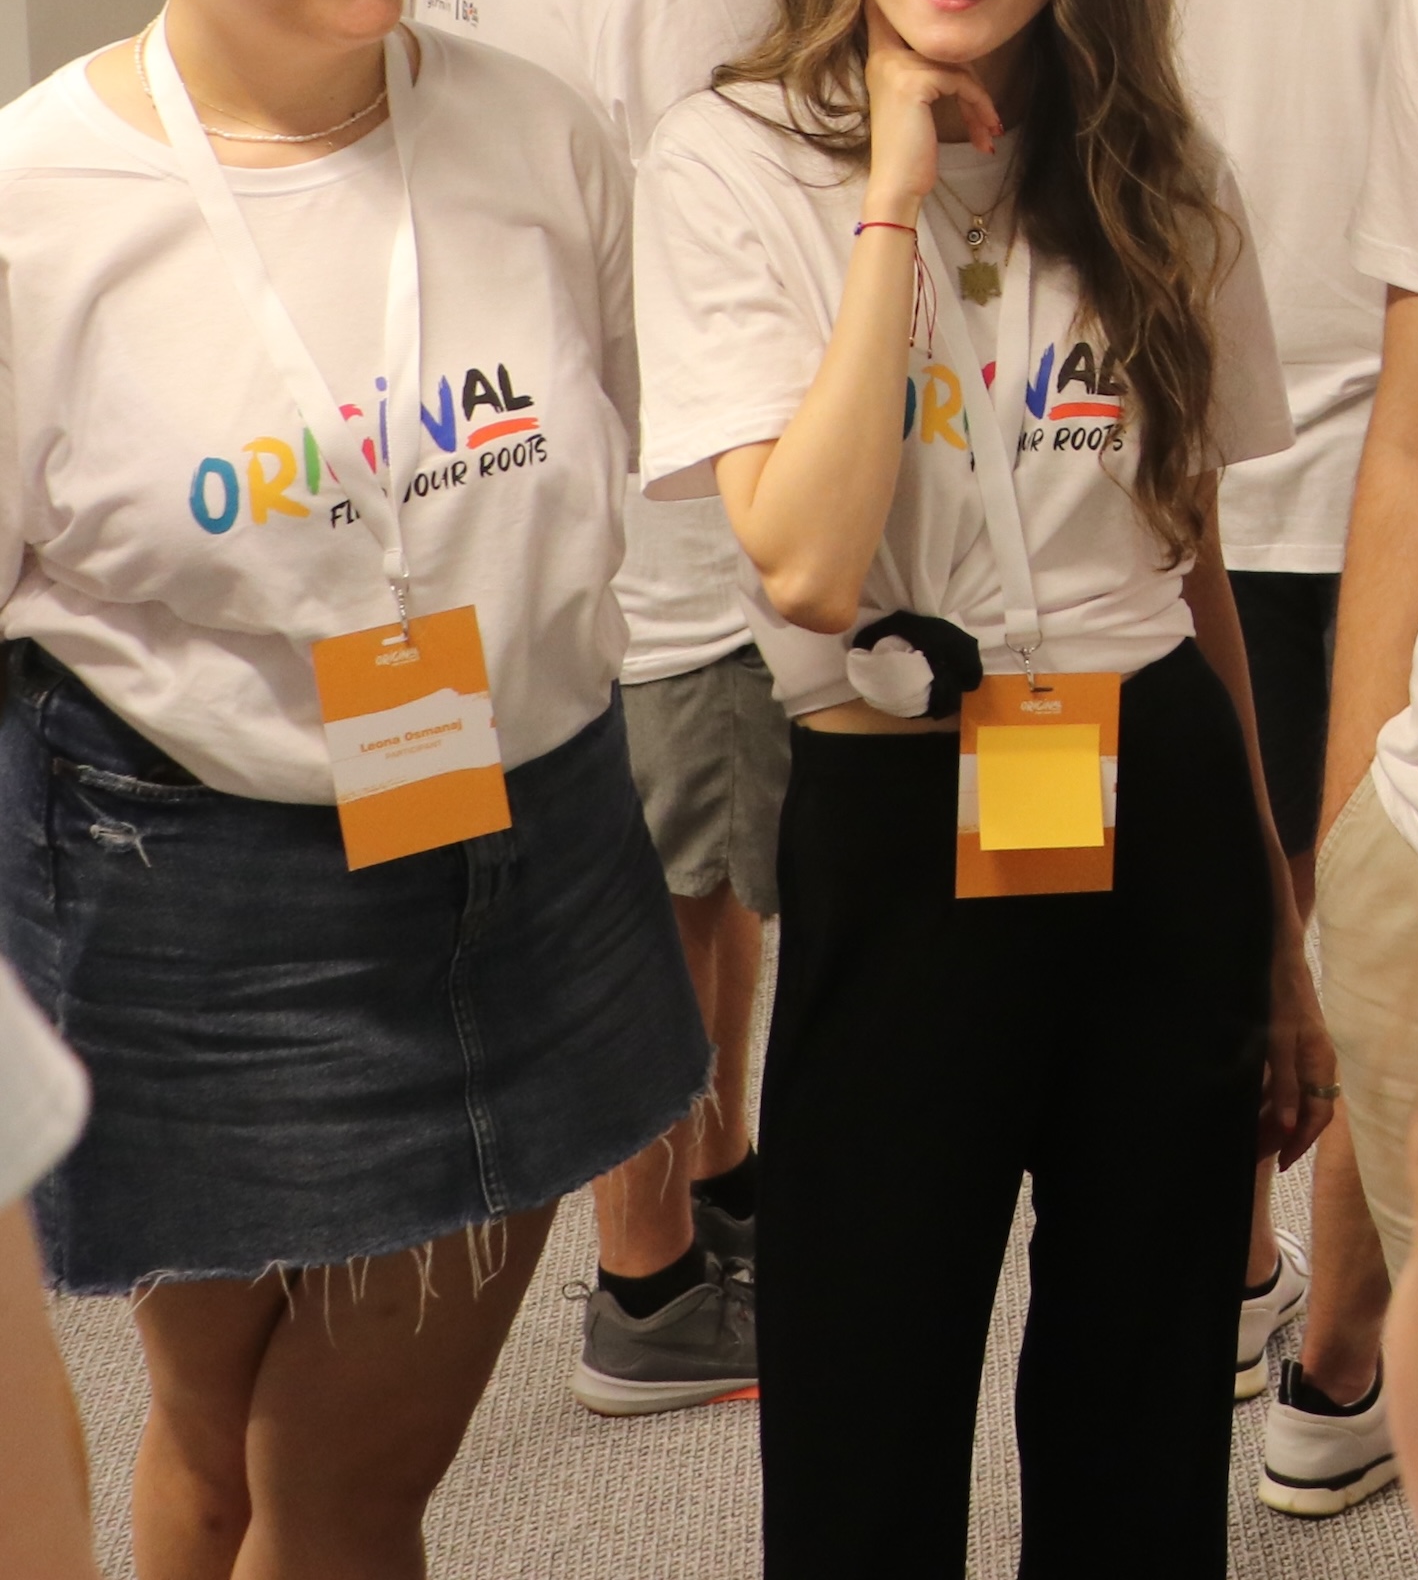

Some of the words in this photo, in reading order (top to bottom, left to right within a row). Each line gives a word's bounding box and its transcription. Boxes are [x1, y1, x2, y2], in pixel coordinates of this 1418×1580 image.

[479, 433, 548, 477] ROOTS
[360, 737, 400, 753] Leona
[405, 718, 462, 742] Osmanaj
